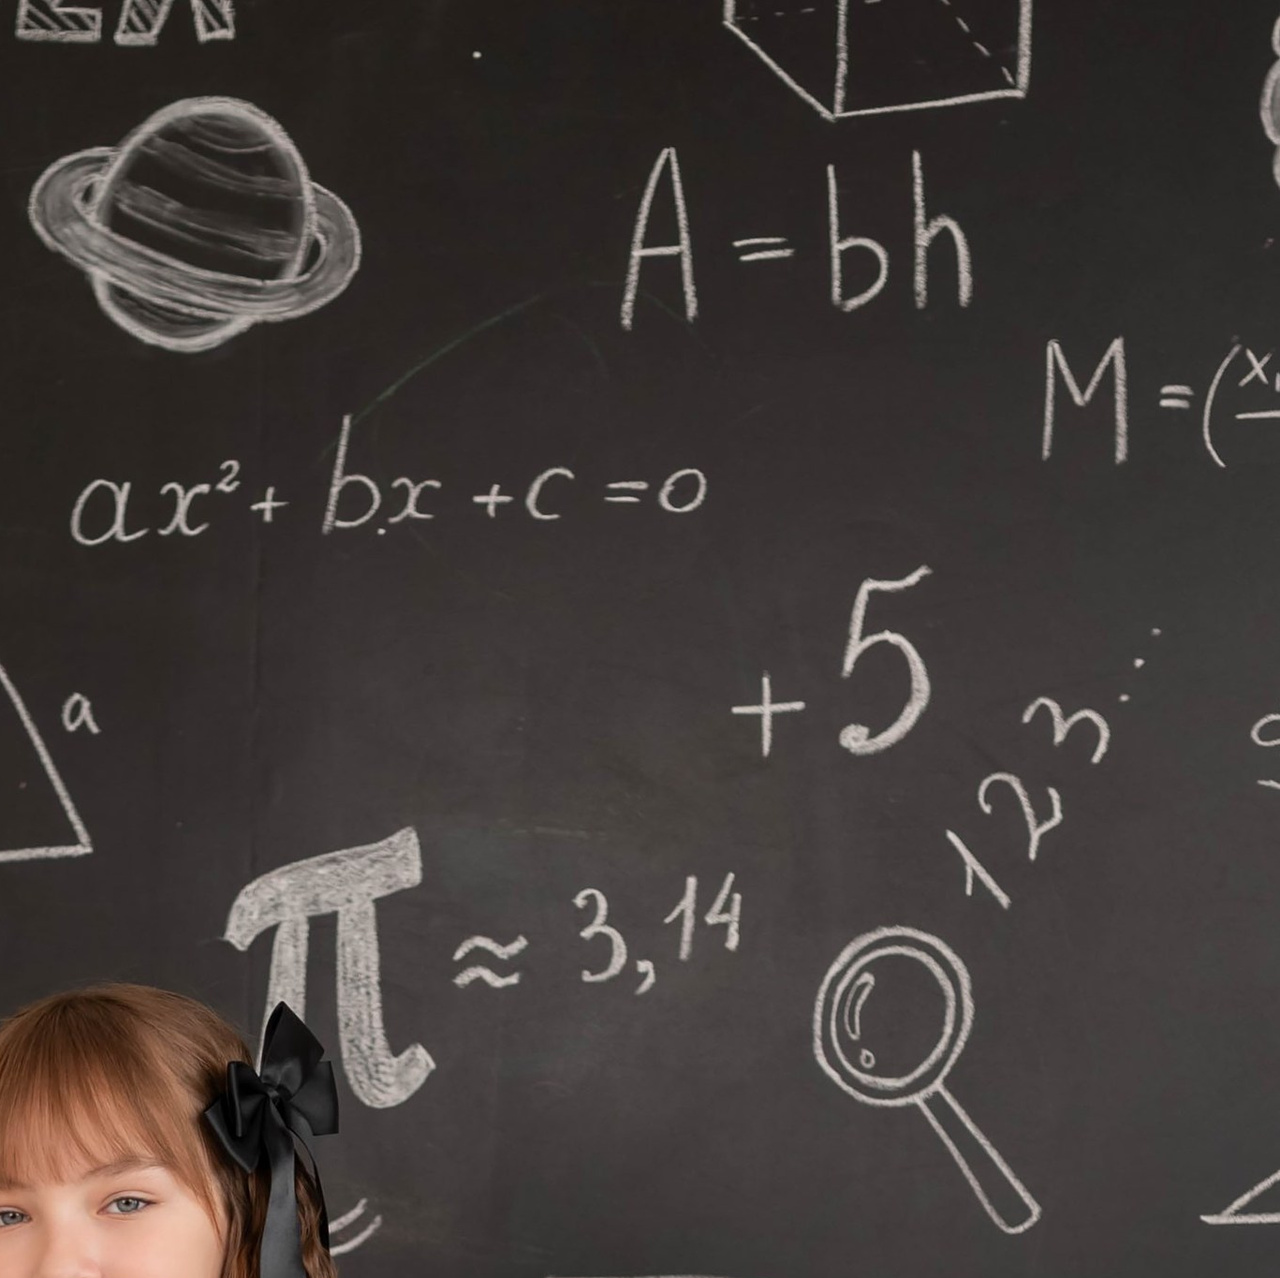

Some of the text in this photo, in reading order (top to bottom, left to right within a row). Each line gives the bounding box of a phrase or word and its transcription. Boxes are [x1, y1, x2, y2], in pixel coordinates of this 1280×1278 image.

[621, 147, 698, 330] A
[1042, 337, 1128, 464] M
[61, 692, 101, 734] a
[572, 872, 742, 994] 3,14
